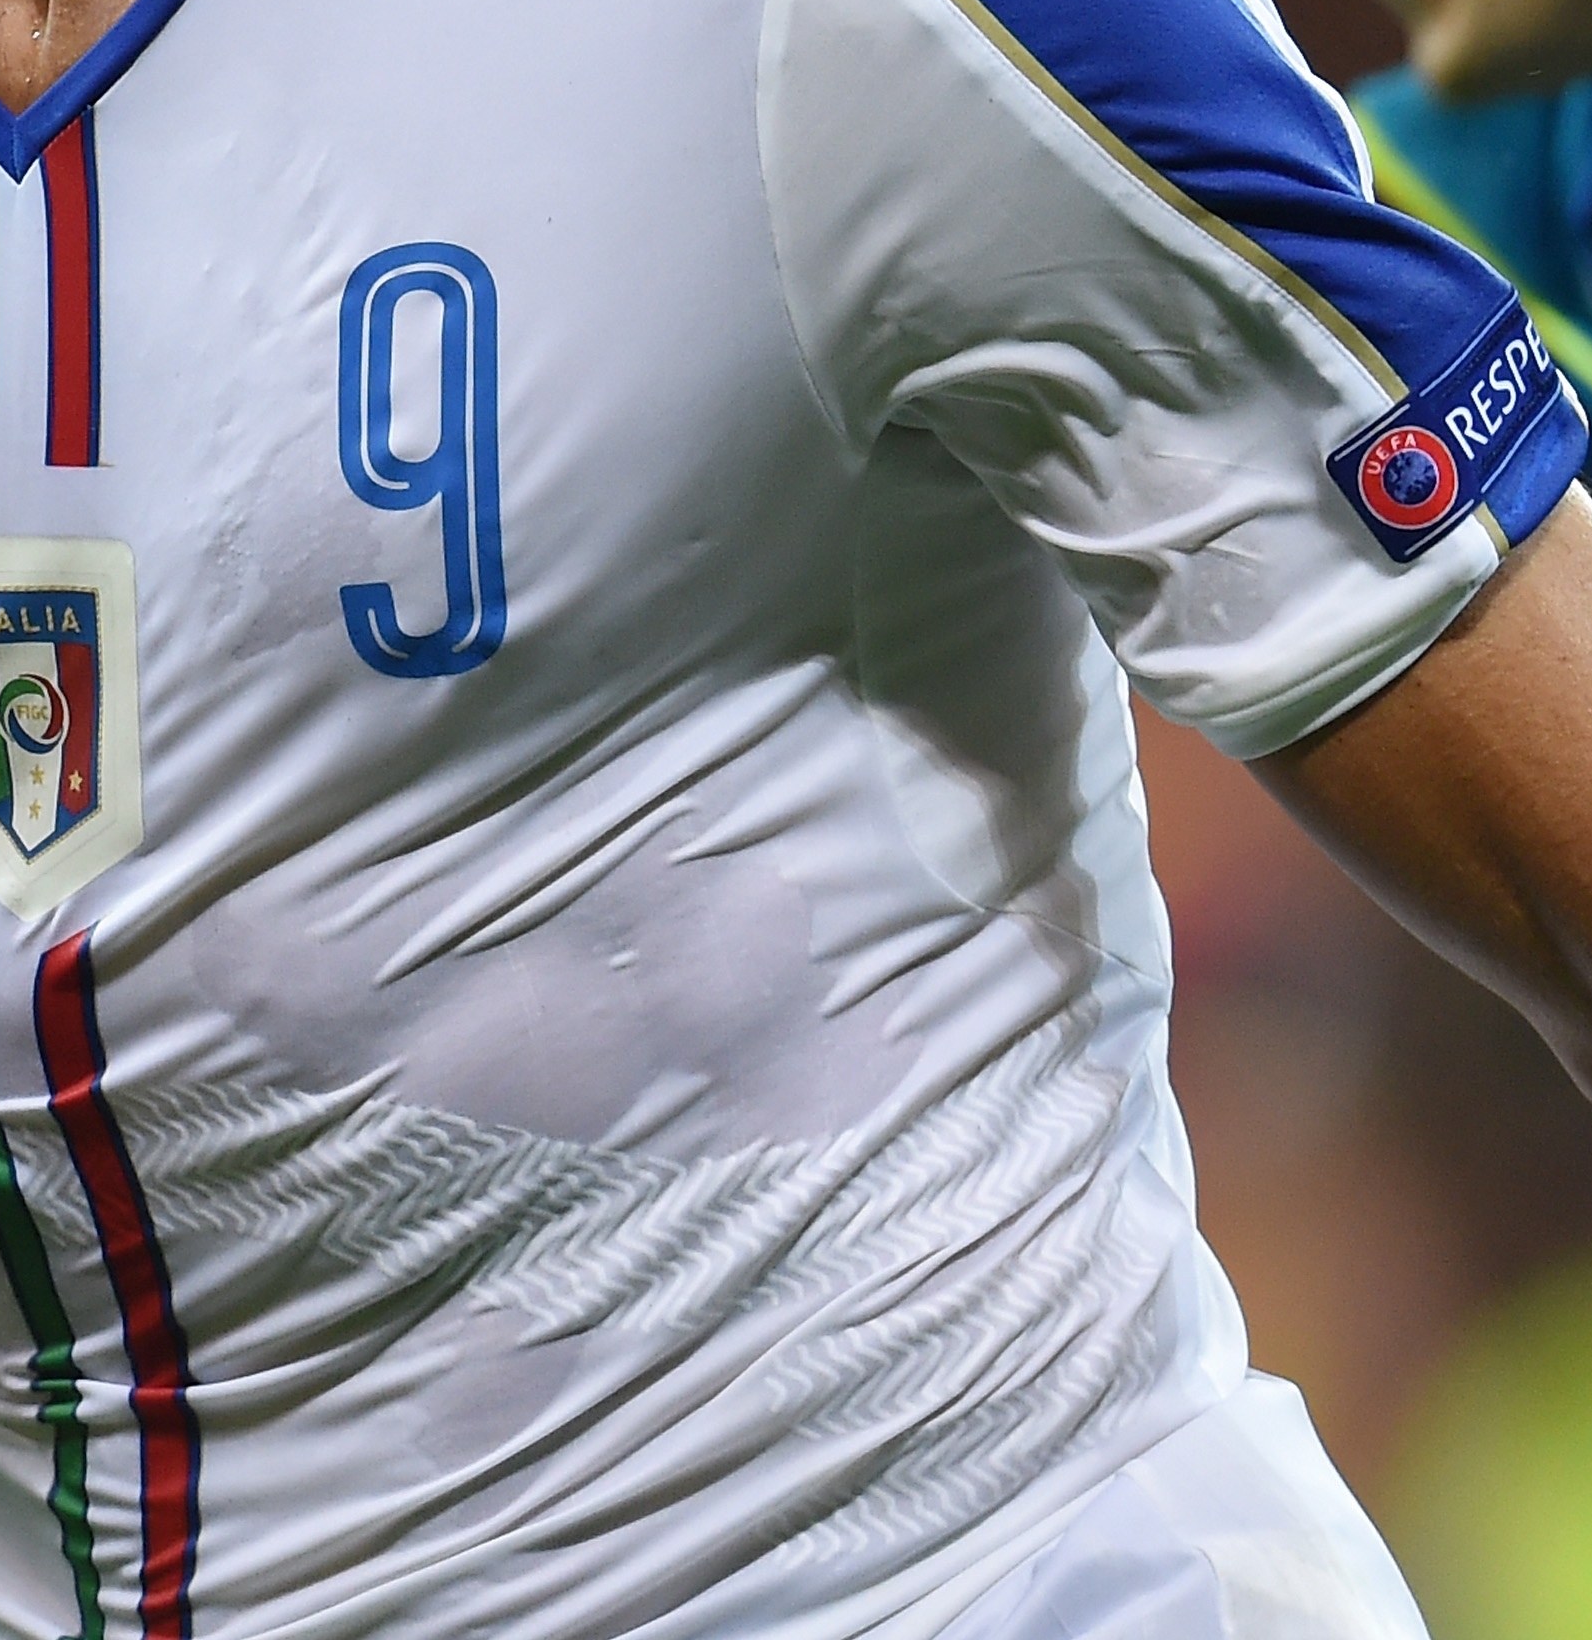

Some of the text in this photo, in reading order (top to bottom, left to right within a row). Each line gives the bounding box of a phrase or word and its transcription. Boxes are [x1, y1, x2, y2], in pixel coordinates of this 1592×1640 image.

[337, 242, 507, 678] 9
[1366, 433, 1417, 475] UEFA
[16, 704, 49, 719] FIGC
